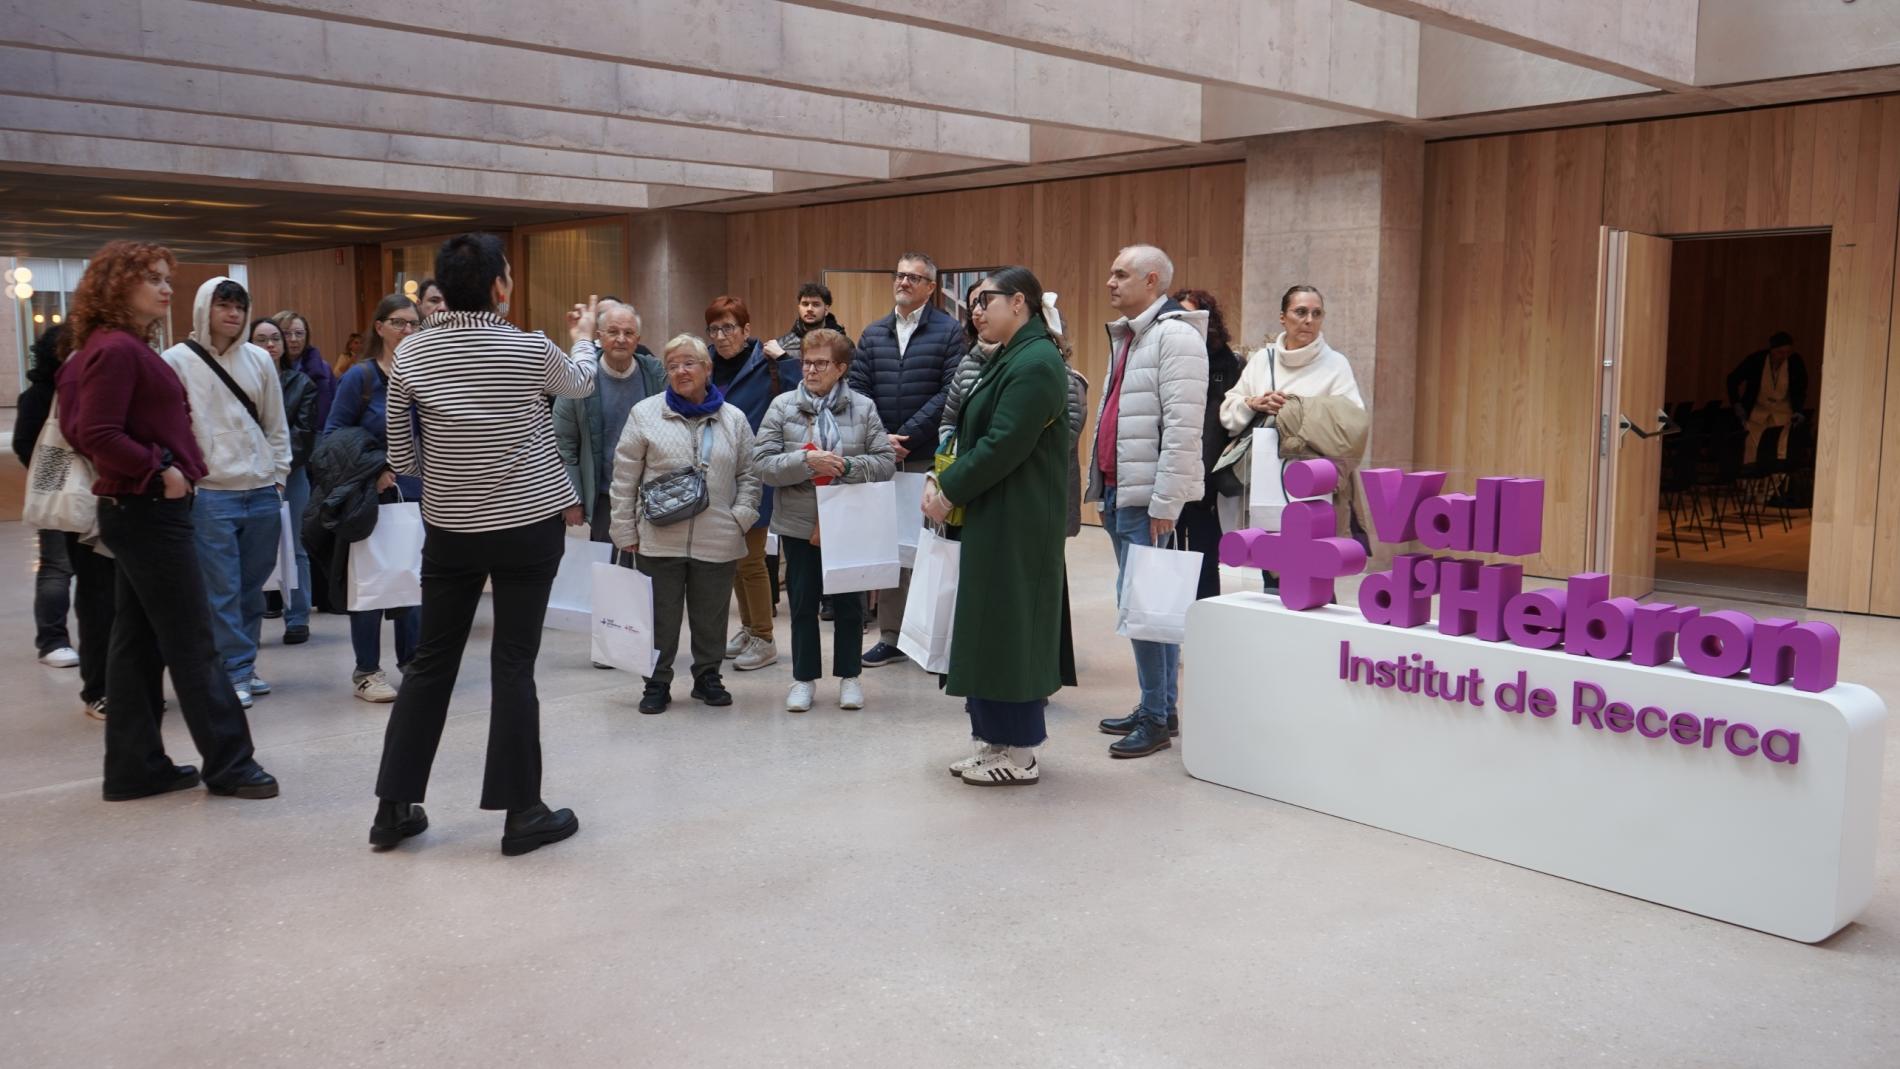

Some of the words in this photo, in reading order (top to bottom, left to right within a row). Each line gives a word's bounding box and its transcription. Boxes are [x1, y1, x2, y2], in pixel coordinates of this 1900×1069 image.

[1360, 468, 1545, 557] Vall
[1358, 553, 1841, 693] d’Hebron
[1339, 641, 1485, 708] Institut
[1494, 671, 1558, 719] de
[1573, 680, 1801, 766] Recerca
